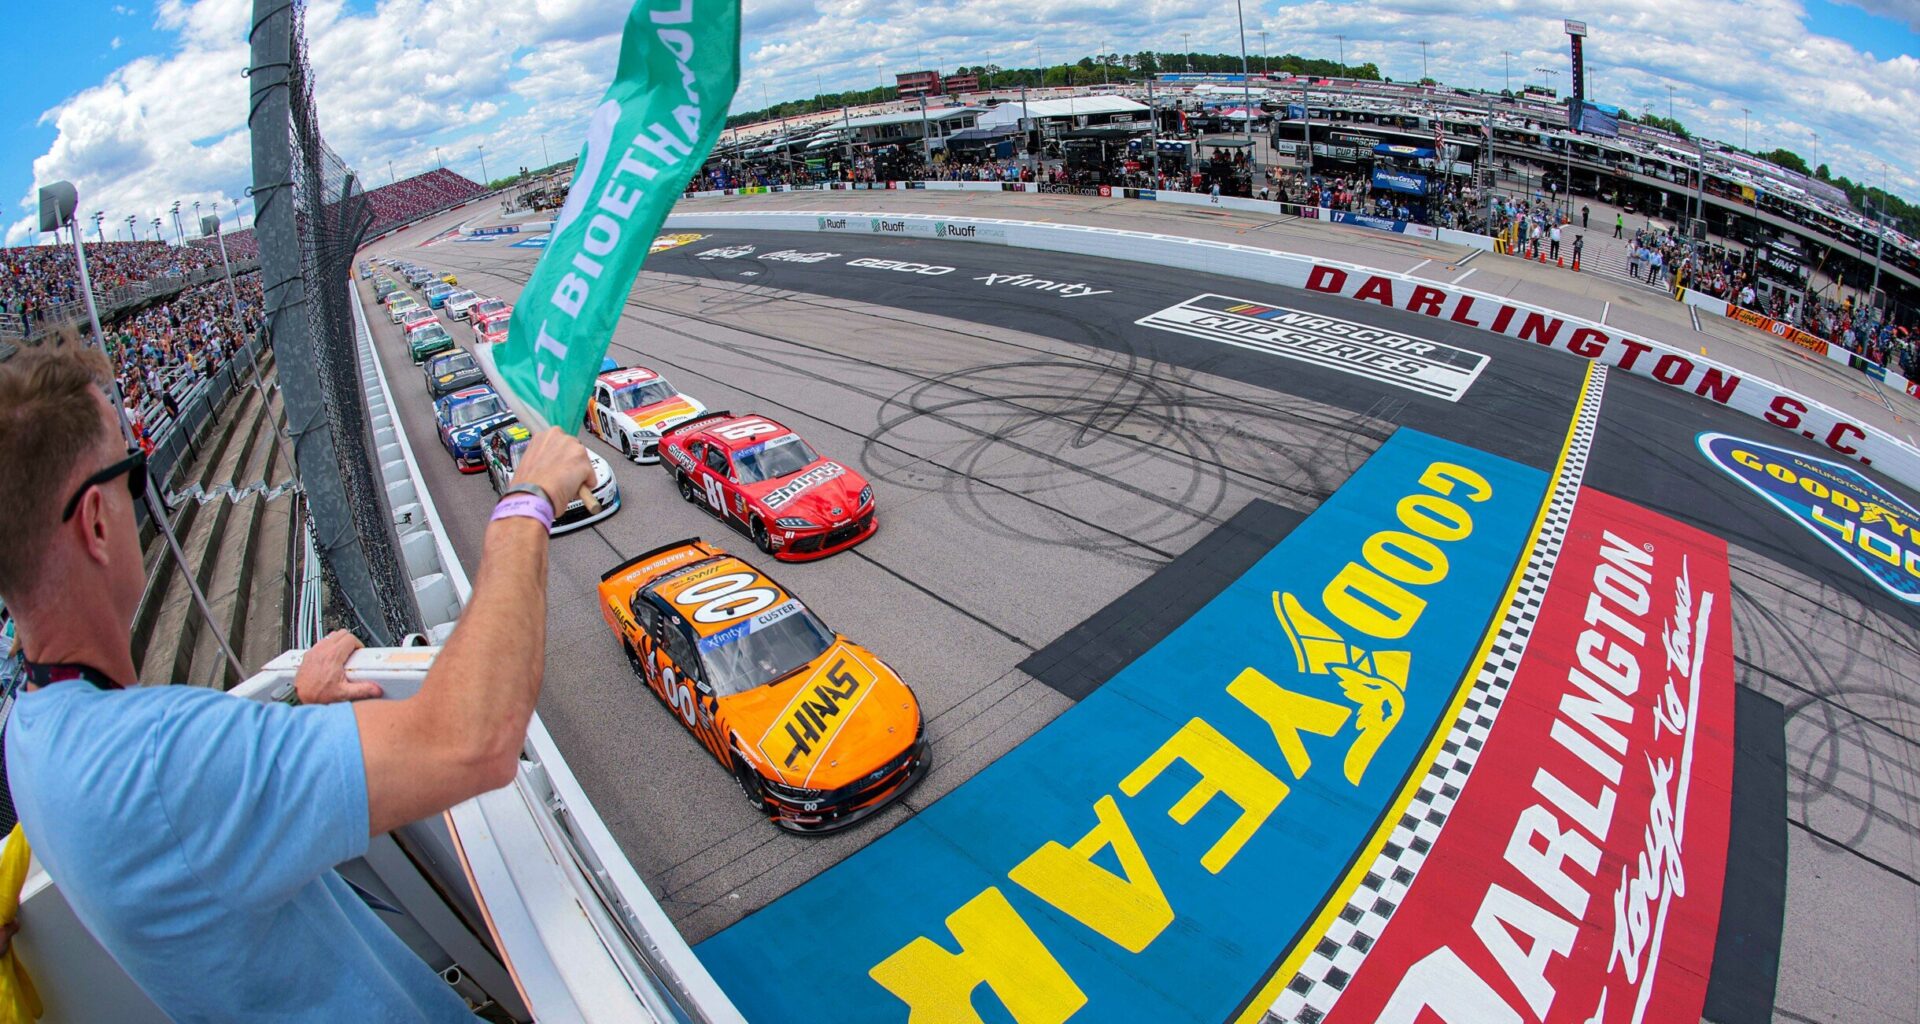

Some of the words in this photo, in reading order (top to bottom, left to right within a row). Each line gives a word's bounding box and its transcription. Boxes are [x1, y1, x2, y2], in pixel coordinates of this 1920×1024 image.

[1040, 183, 1098, 197] HeGetsUs.com
[827, 219, 846, 230] Ruoff
[882, 221, 905, 233] Ruoff
[948, 224, 976, 237] Ruoff
[1333, 212, 1345, 223] 17
[846, 257, 956, 276] GEICO
[1271, 311, 1438, 356] NASCAR
[1771, 322, 1786, 336] 00
[1190, 315, 1280, 337] CUP
[1271, 331, 1429, 376] SERIES
[1305, 264, 1741, 405] DARLINGTON
[1763, 395, 1873, 466] S.C.
[1908, 384, 1918, 396] 4
[597, 408, 612, 439] 18
[1794, 458, 1868, 496] DARLINGTON
[702, 472, 729, 518] 81
[785, 531, 795, 539] 81
[675, 573, 778, 624] 00
[758, 603, 796, 625] CUSTER
[1664, 554, 1692, 677] tame
[707, 627, 742, 648] xfinity
[662, 667, 696, 726] 00
[1654, 677, 1686, 740] to
[784, 657, 859, 768] HAAS
[868, 461, 1494, 1024] GOODYEAR
[803, 803, 818, 812] 00
[1607, 750, 1685, 985] tough
